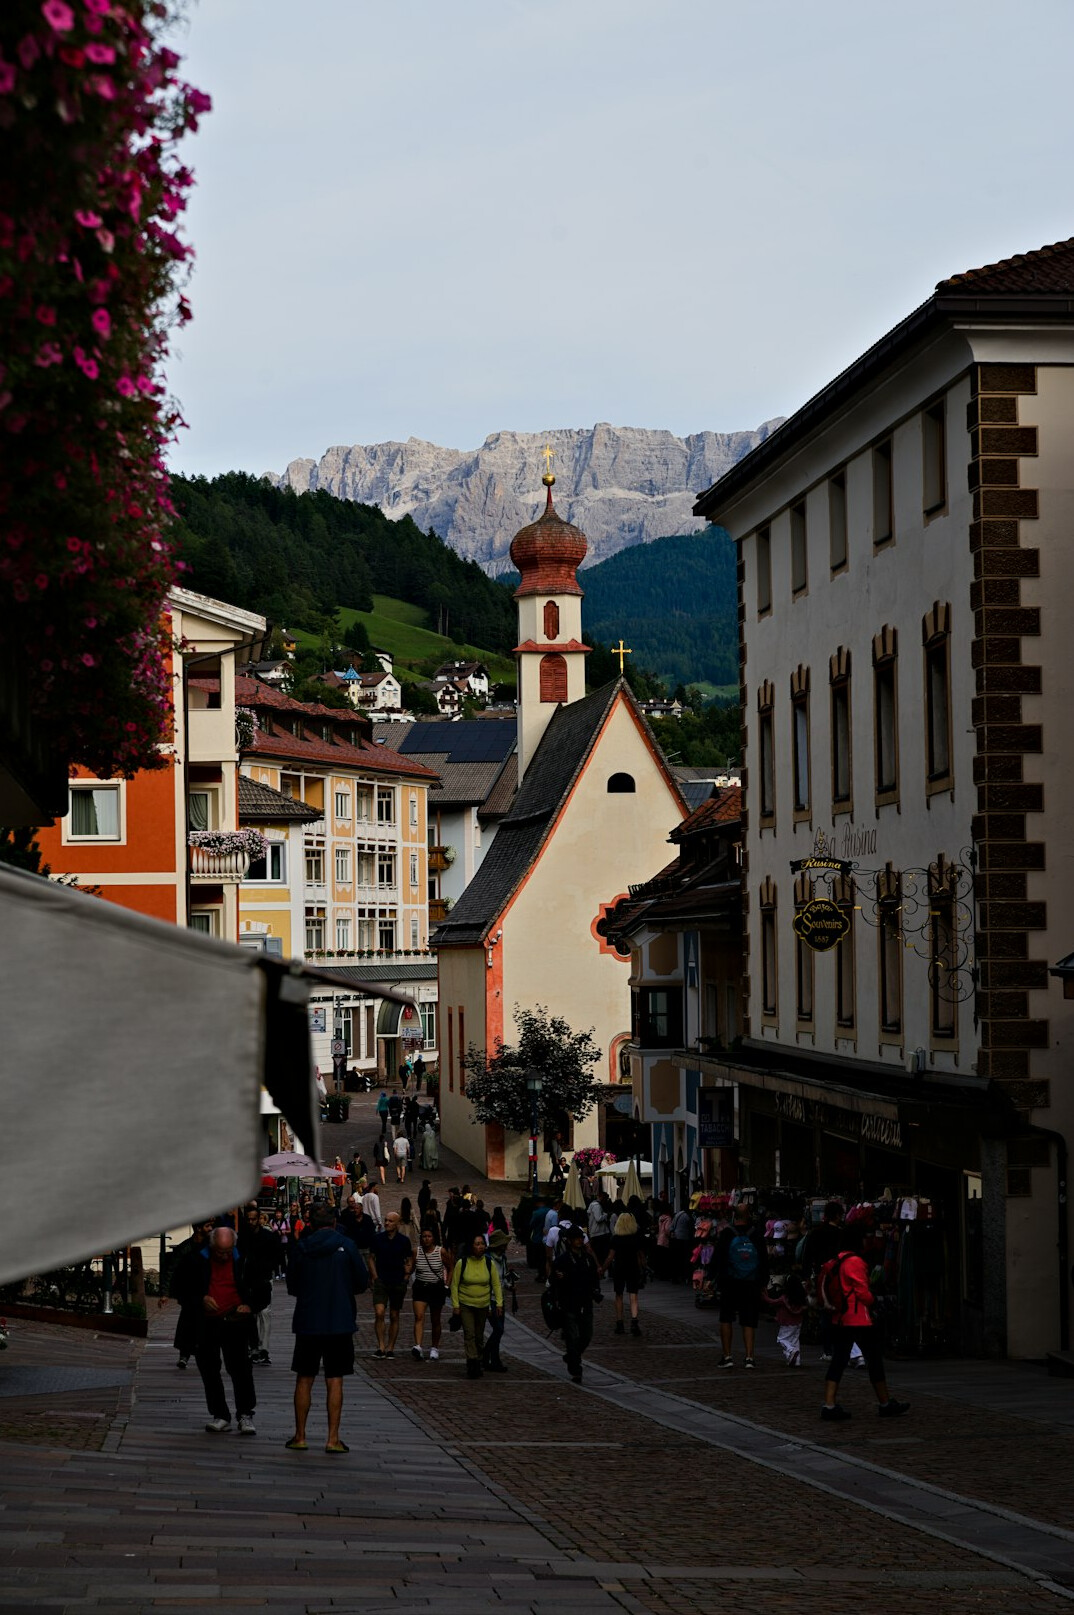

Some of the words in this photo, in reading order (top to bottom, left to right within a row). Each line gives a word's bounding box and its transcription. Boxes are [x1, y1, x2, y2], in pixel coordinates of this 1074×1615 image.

[841, 822, 877, 858] Rusina
[801, 858, 842, 870] Rusina
[801, 912, 843, 935] Souvenirs
